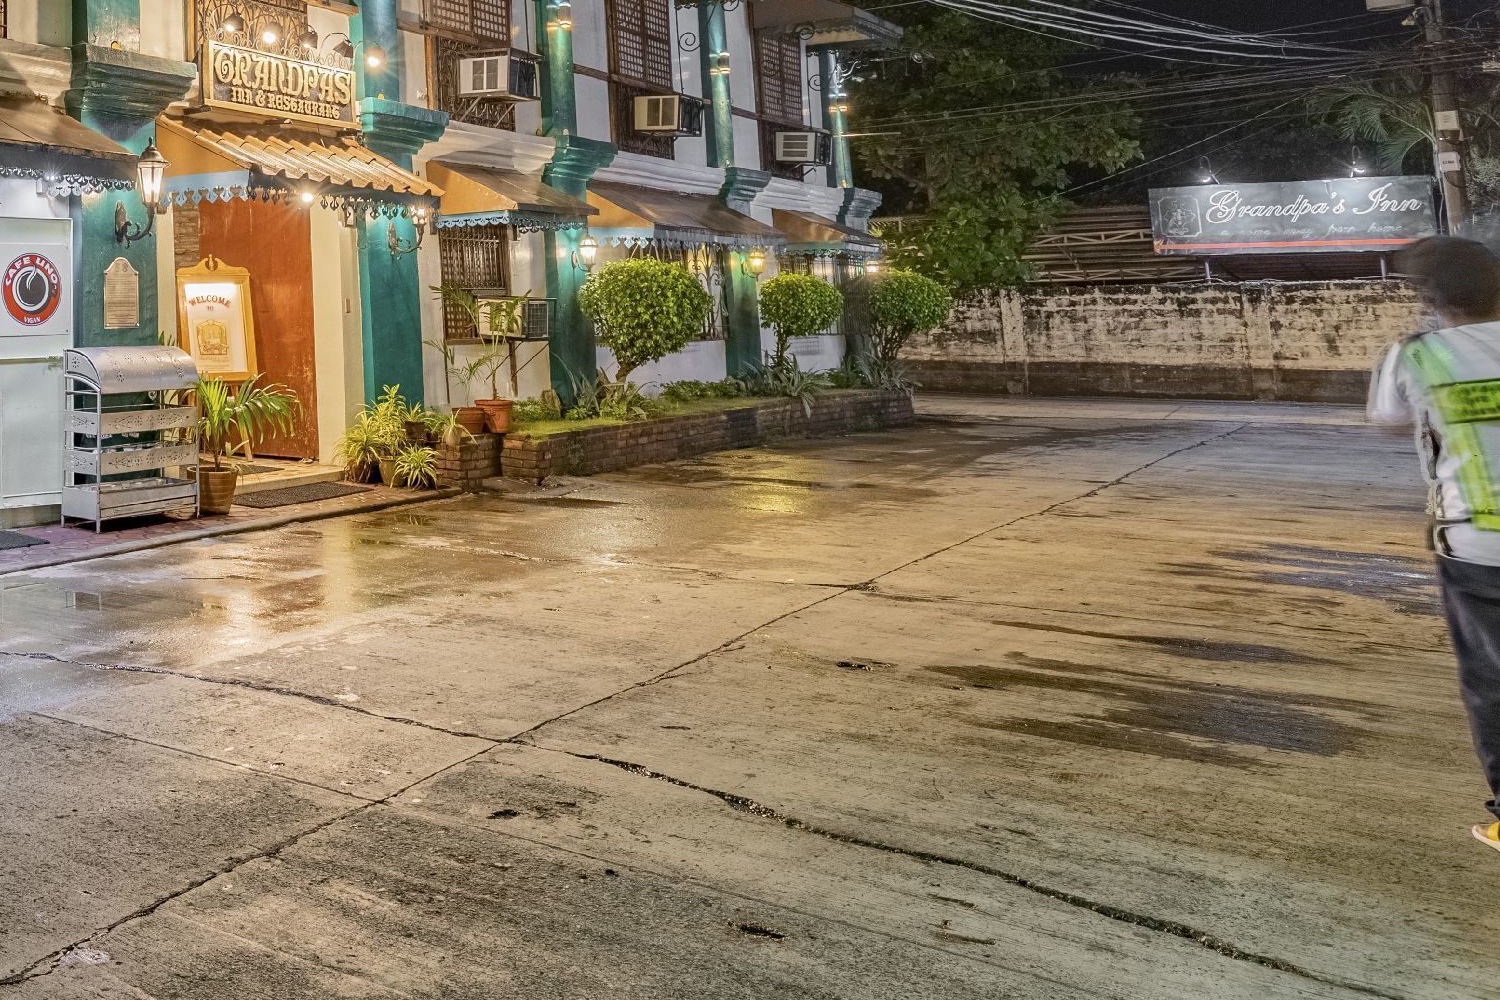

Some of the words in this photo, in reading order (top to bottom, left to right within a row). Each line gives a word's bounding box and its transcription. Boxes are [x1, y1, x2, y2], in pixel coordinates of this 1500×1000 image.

[255, 90, 266, 107] &
[1205, 189, 1346, 224] Grandpa's
[1352, 182, 1424, 215] Inn
[5, 256, 31, 287] CAFE
[35, 256, 58, 284] UNO
[188, 294, 232, 308] WELCOME
[23, 315, 41, 324] VIGAN
